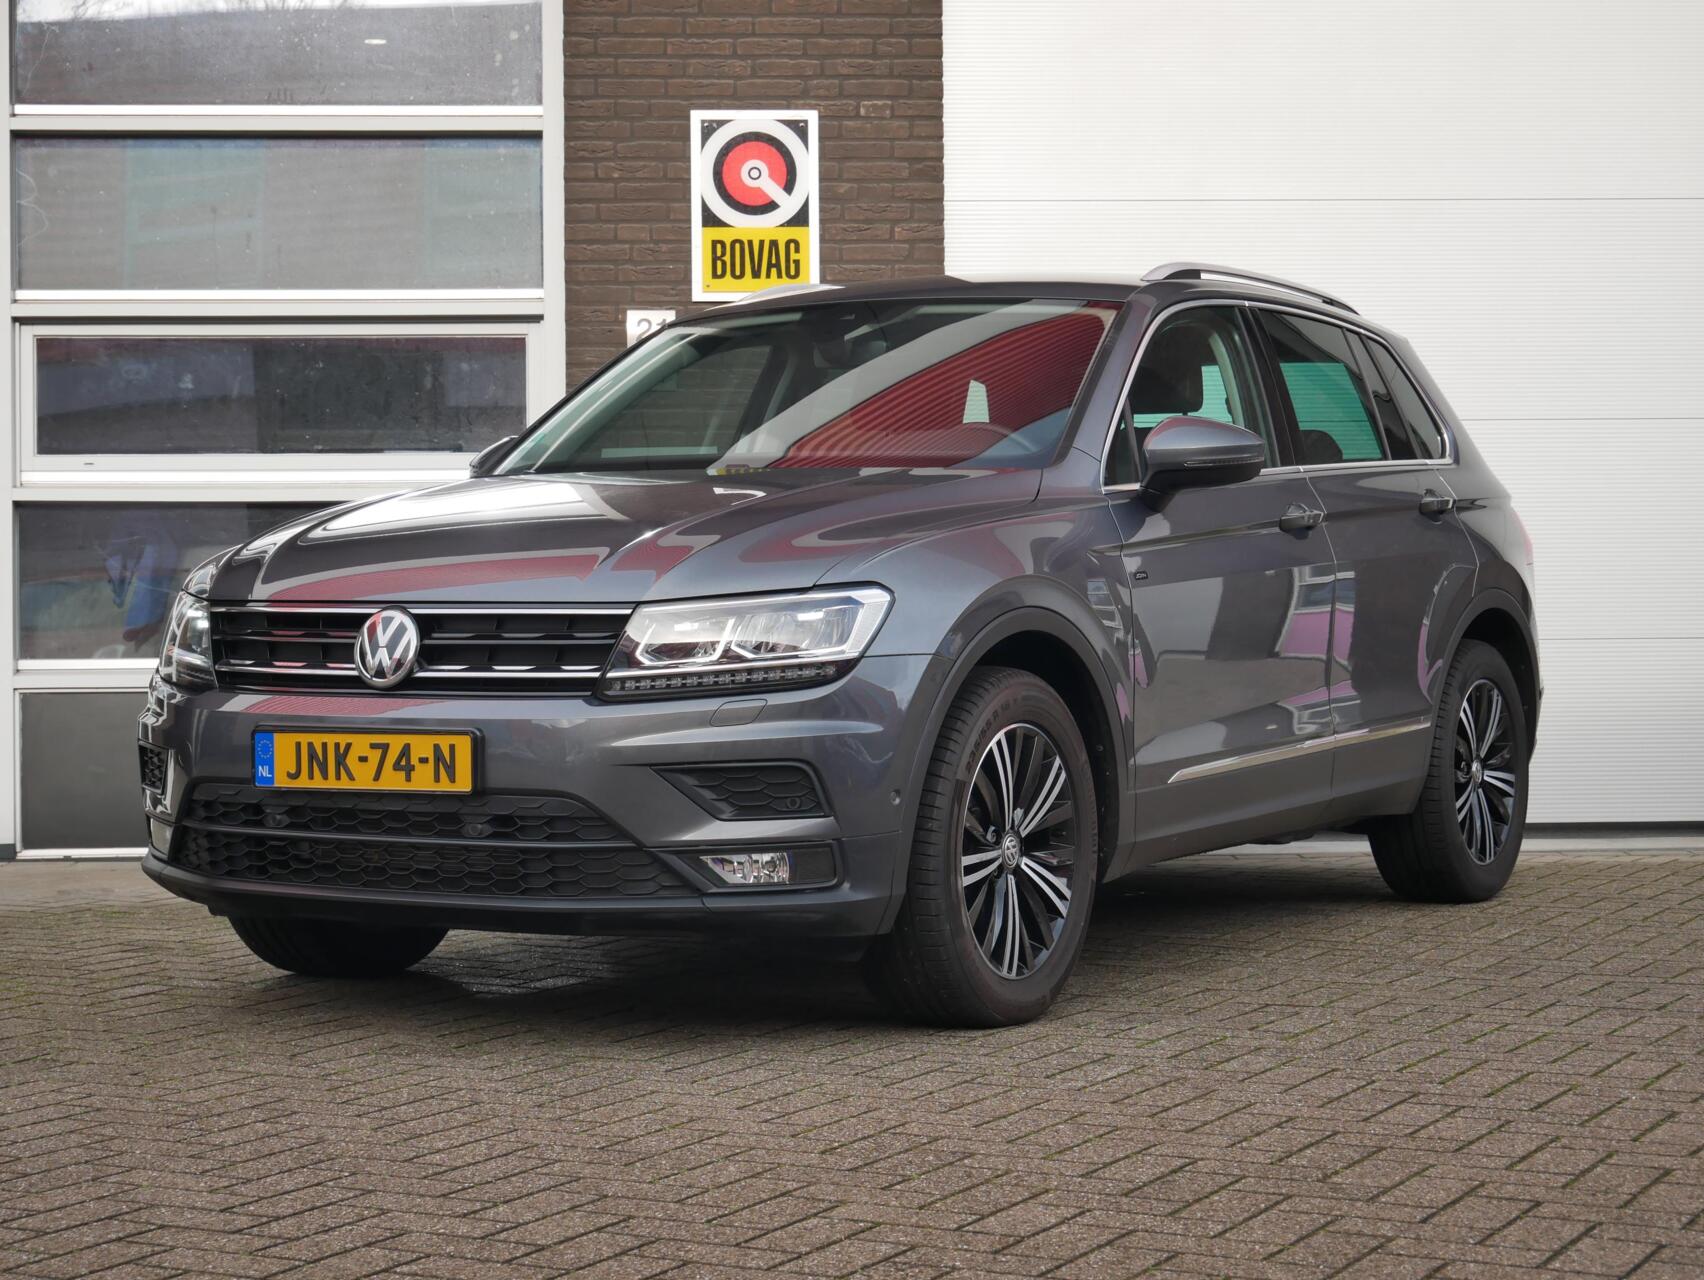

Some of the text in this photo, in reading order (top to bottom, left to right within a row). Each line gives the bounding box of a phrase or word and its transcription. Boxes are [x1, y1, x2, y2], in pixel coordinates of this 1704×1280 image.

[711, 238, 800, 280] BOVAG
[258, 766, 273, 778] NL
[286, 741, 456, 784] JNK-74-N
